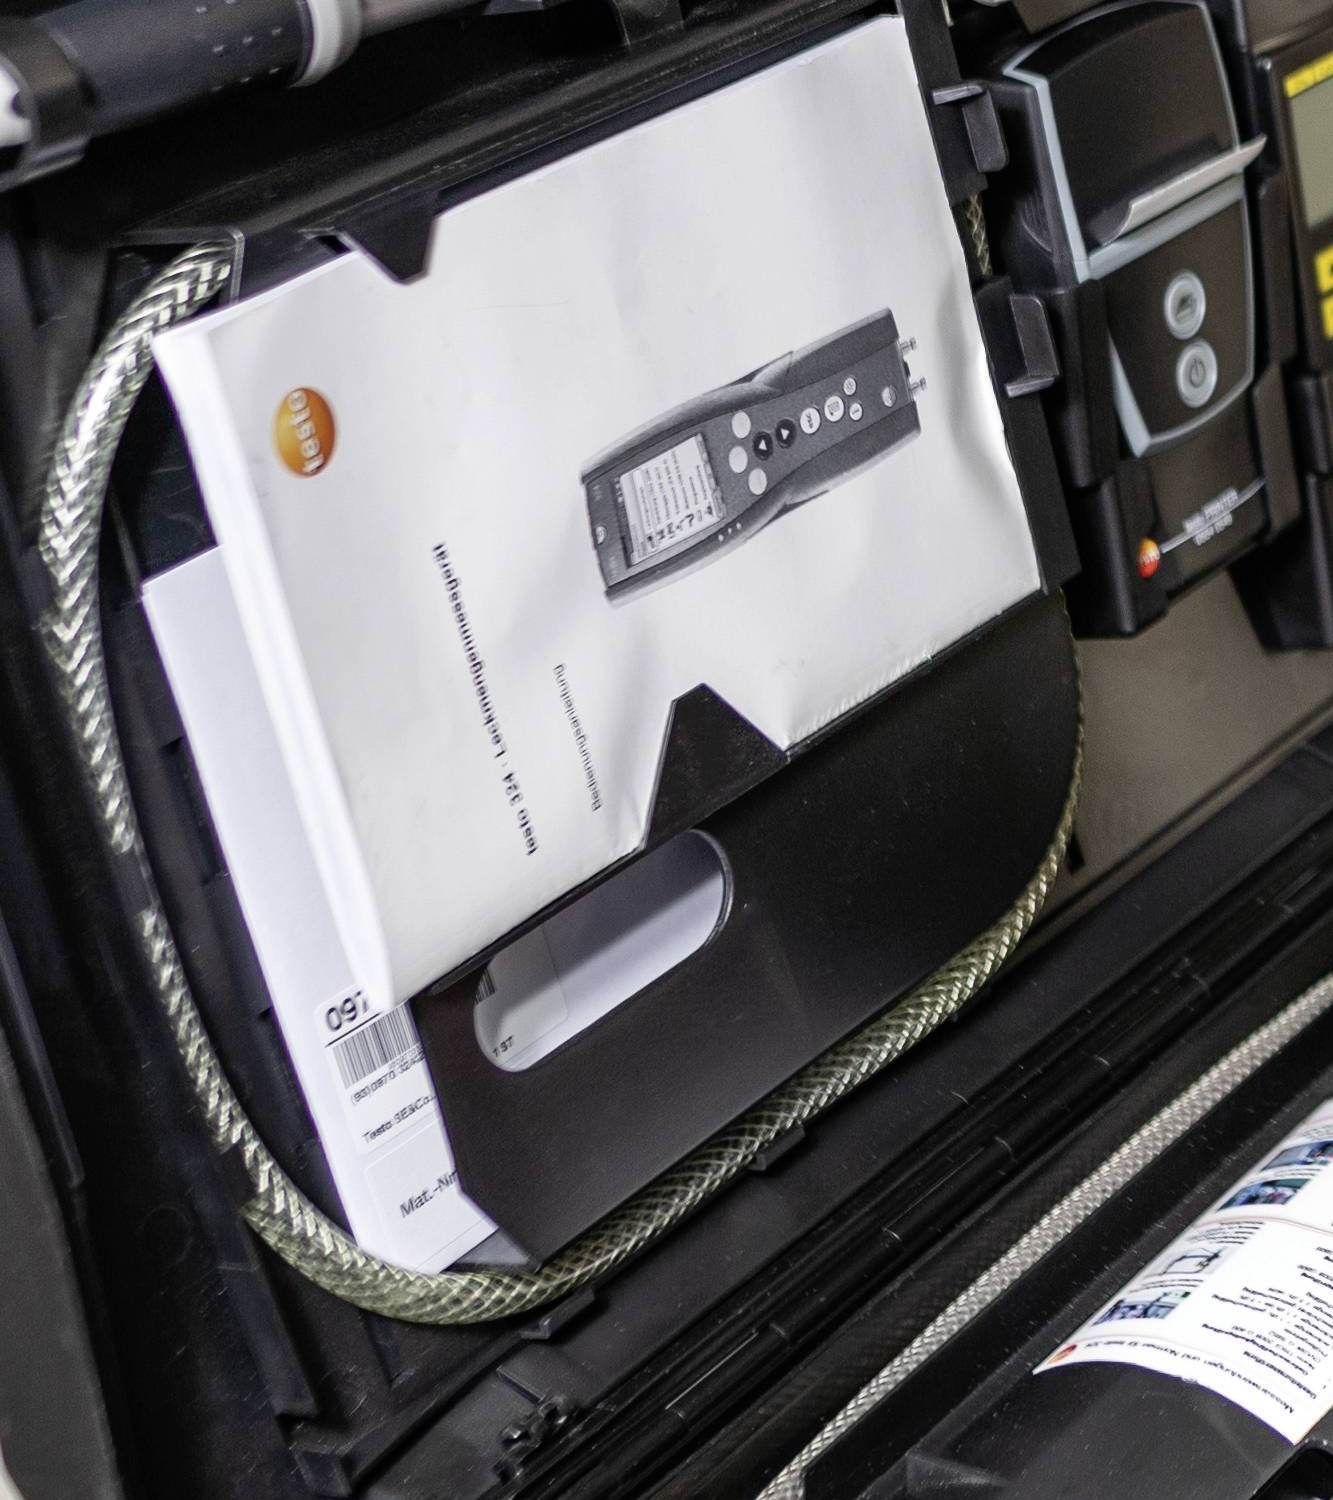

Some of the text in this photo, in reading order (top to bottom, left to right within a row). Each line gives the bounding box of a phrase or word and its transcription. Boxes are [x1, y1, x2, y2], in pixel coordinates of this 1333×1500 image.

[290, 388, 328, 478] testo
[551, 662, 603, 813] Bedienungsanleitung
[502, 771, 525, 807] 324
